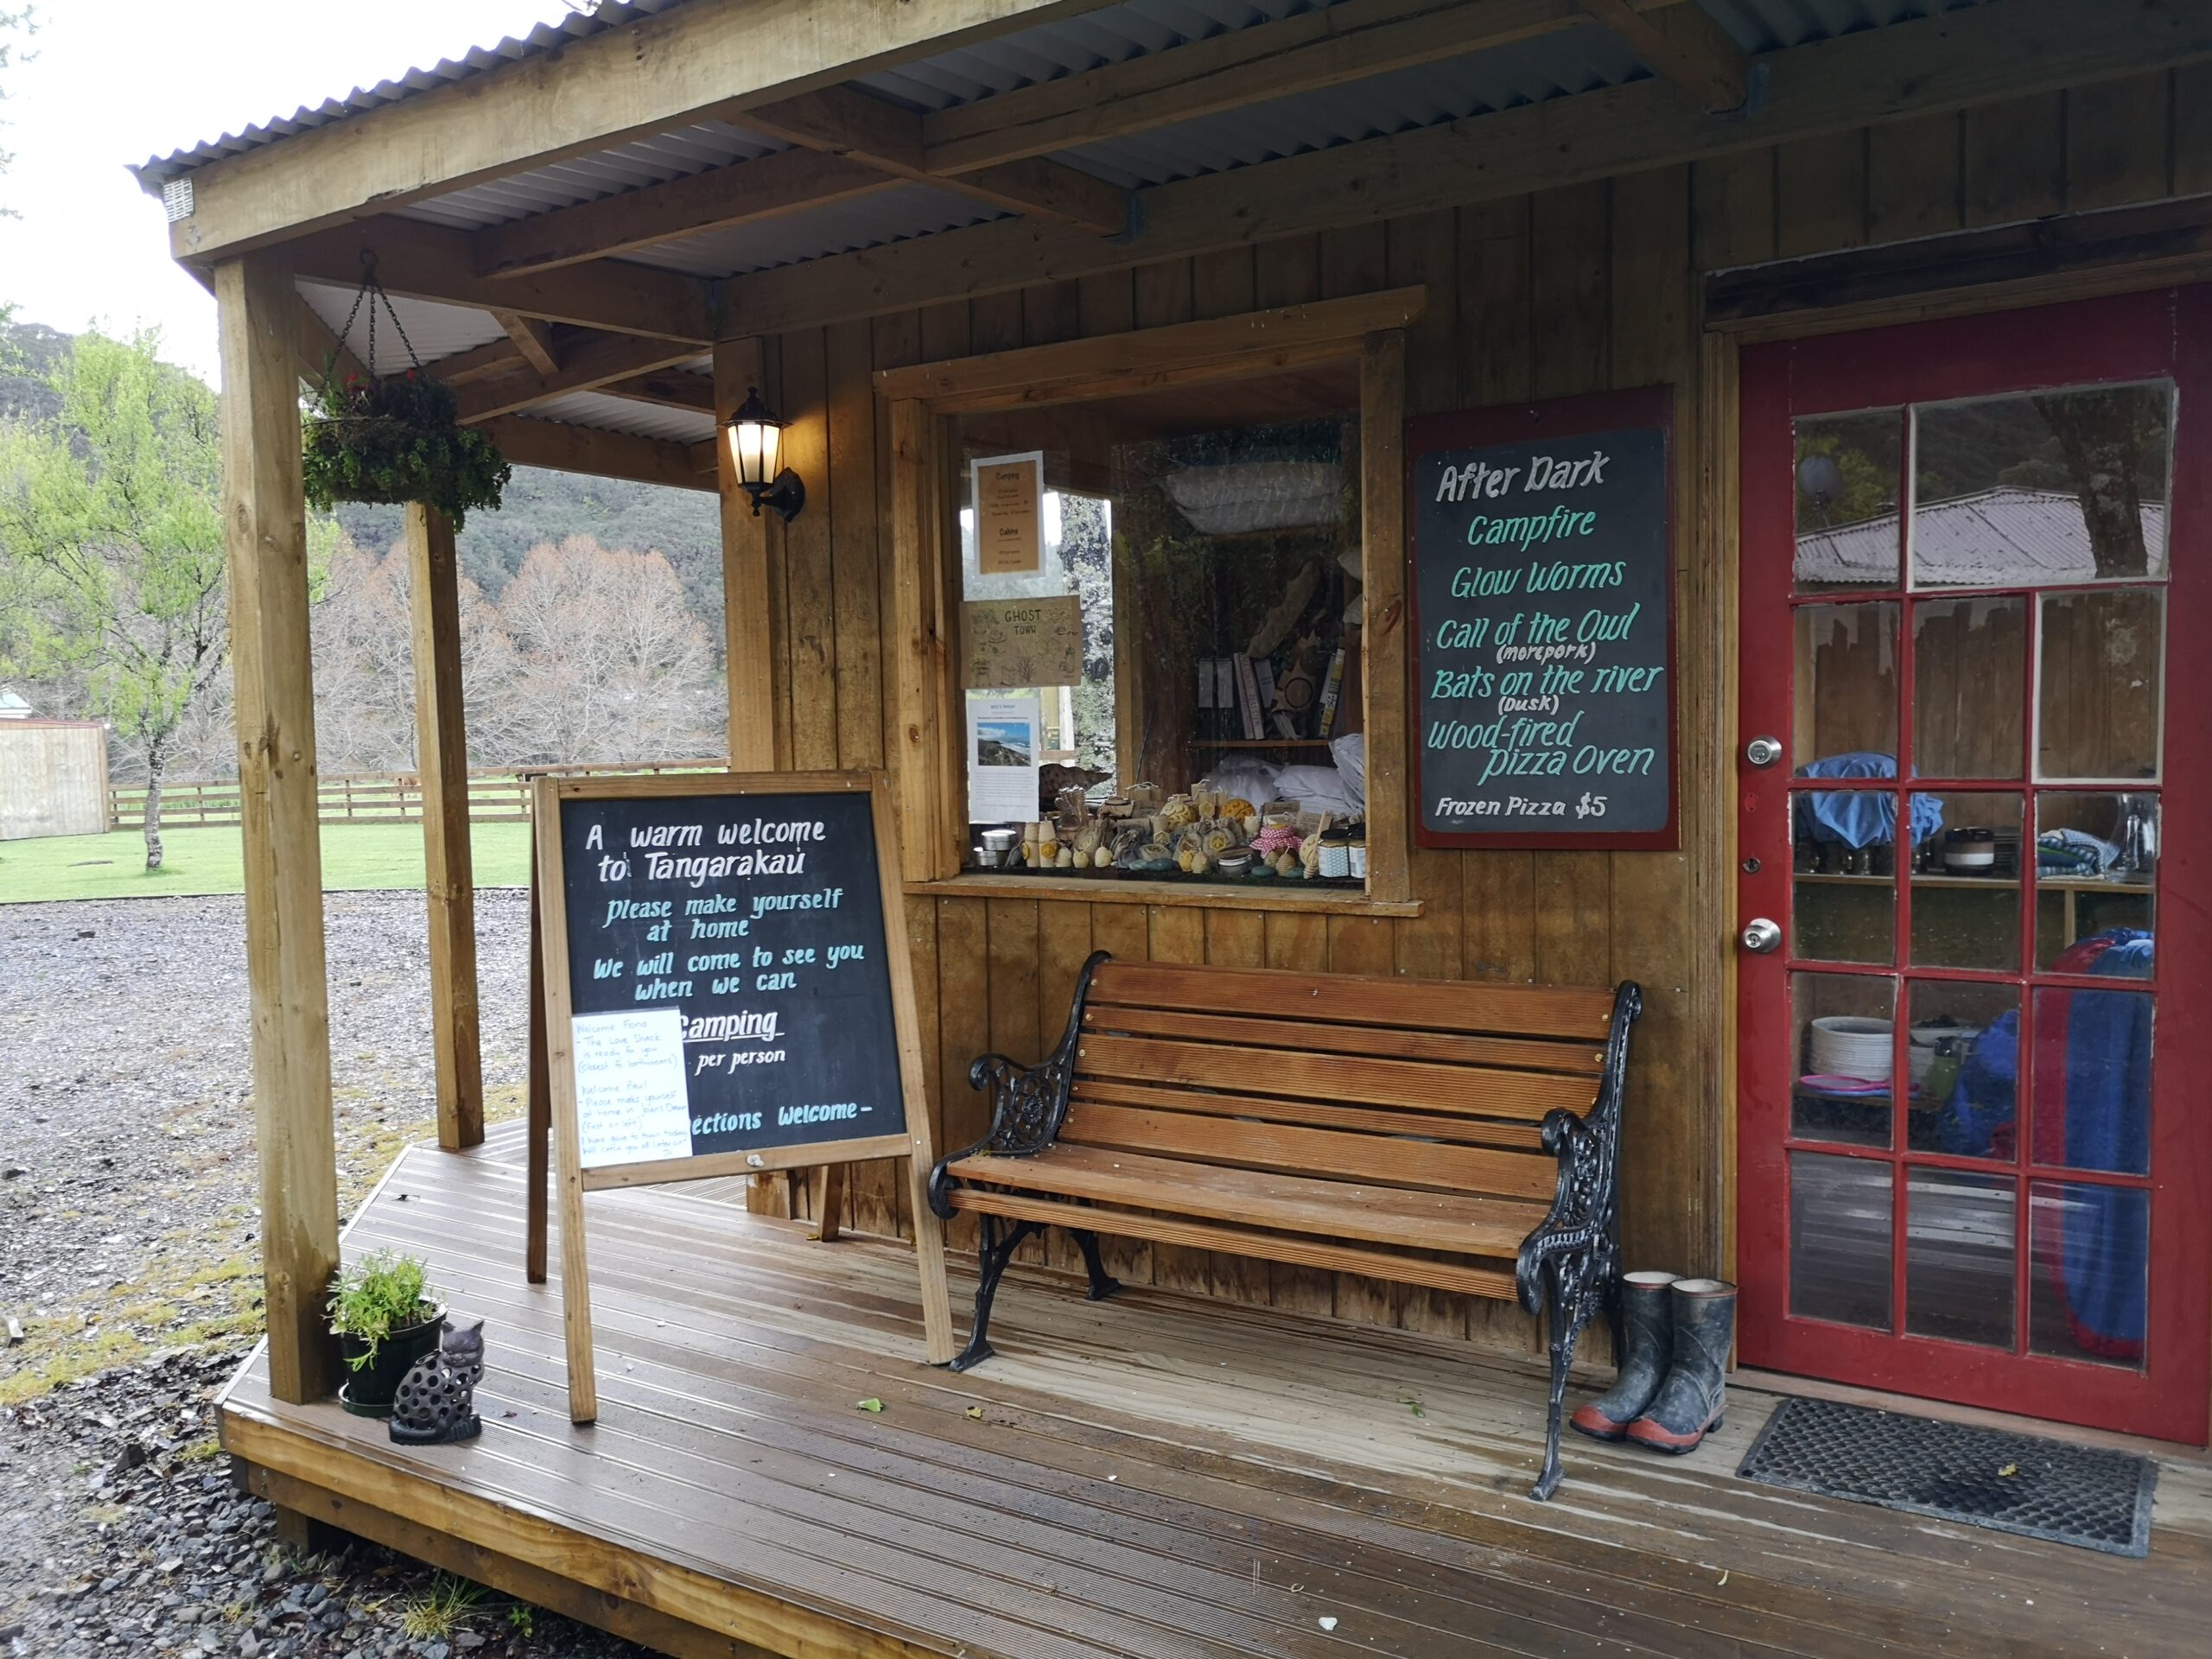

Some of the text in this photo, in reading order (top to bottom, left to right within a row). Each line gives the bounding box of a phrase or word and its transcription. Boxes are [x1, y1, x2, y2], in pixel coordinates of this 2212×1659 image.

[1436, 451, 1610, 501] After Dark
[1468, 505, 1595, 551] Campfire
[1452, 562, 1626, 597] Glow Worms
[1004, 609, 1041, 622] GHOST
[1437, 602, 1640, 649] Call of the Owl
[1013, 626, 1036, 635] TOWN
[1497, 644, 1596, 665] (morepork)
[1431, 664, 1664, 698] Bats on the river
[1498, 695, 1559, 715] (Dusk)
[1428, 709, 1584, 751] Wood-fired
[1573, 746, 1654, 775] Oven
[1435, 792, 1607, 819] Frozen Pizza $5
[586, 818, 825, 849] A warm welcome
[598, 851, 805, 887] to Tangarakau
[602, 888, 843, 929] please make yourself
[647, 918, 748, 941] at home
[594, 945, 864, 979] We will come to see you
[635, 972, 797, 1001] when we can
[576, 1024, 615, 1033] Welcome
[695, 1051, 785, 1076] per person
[582, 1085, 621, 1095] Welcome
[693, 1112, 762, 1135] ections
